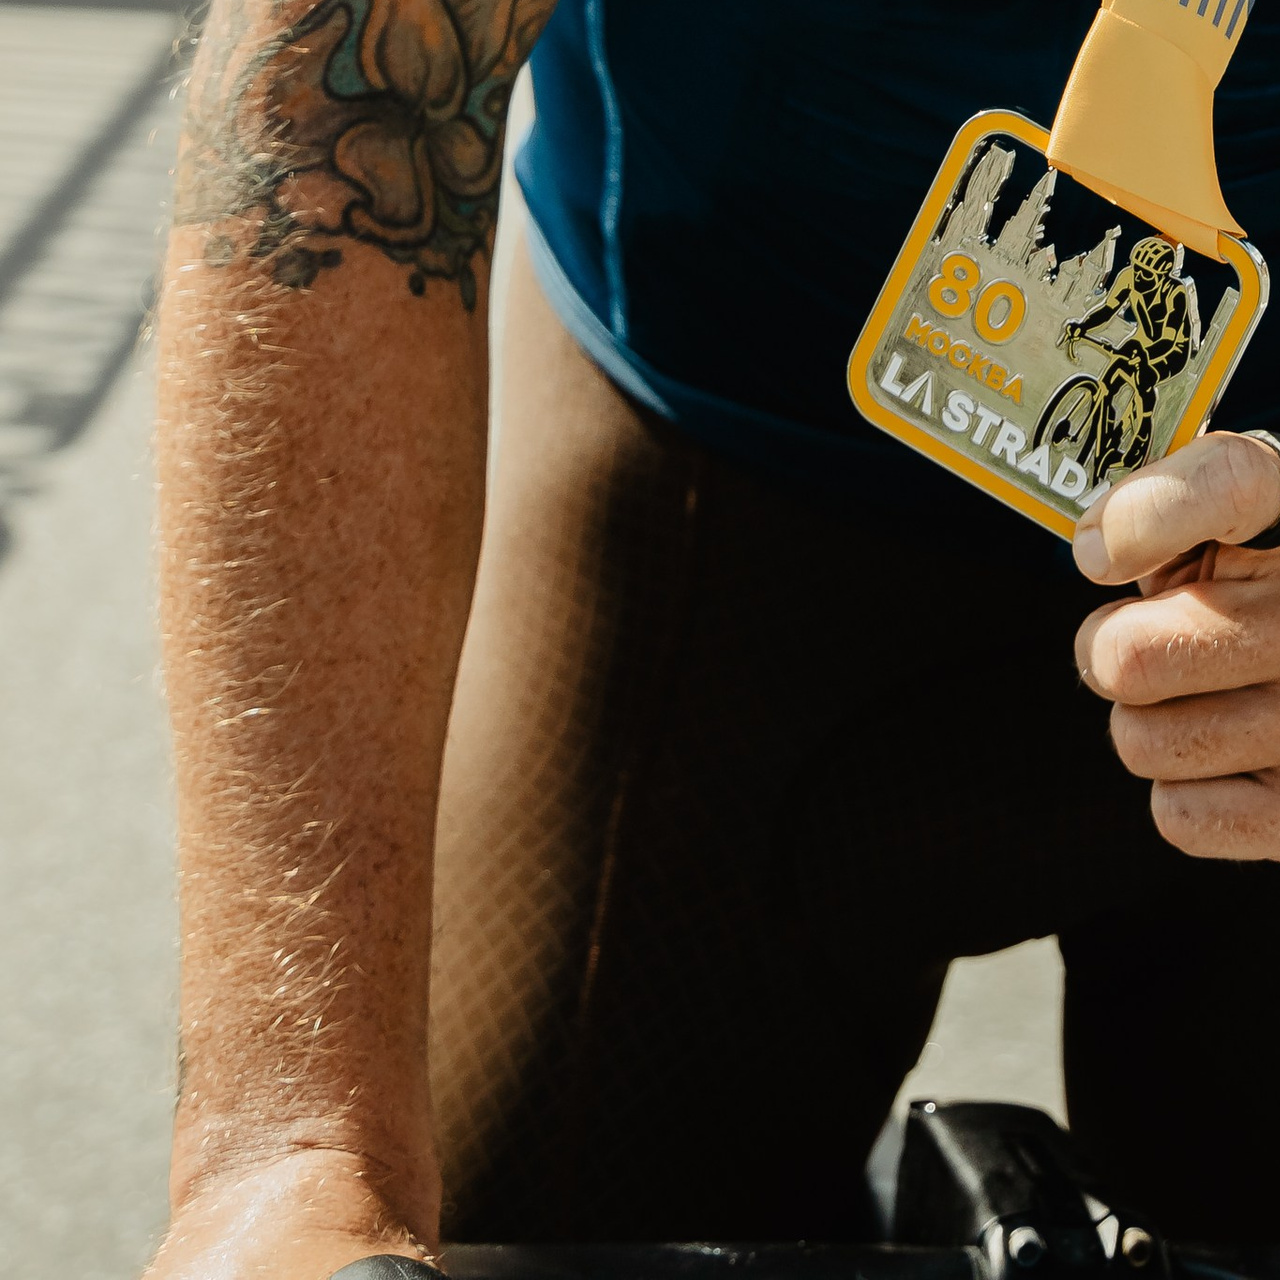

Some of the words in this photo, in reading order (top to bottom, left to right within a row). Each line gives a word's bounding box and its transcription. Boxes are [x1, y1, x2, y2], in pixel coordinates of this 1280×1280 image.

[928, 251, 1028, 345] 80
[880, 351, 935, 416] LA
[904, 312, 1024, 404] МОСКВА
